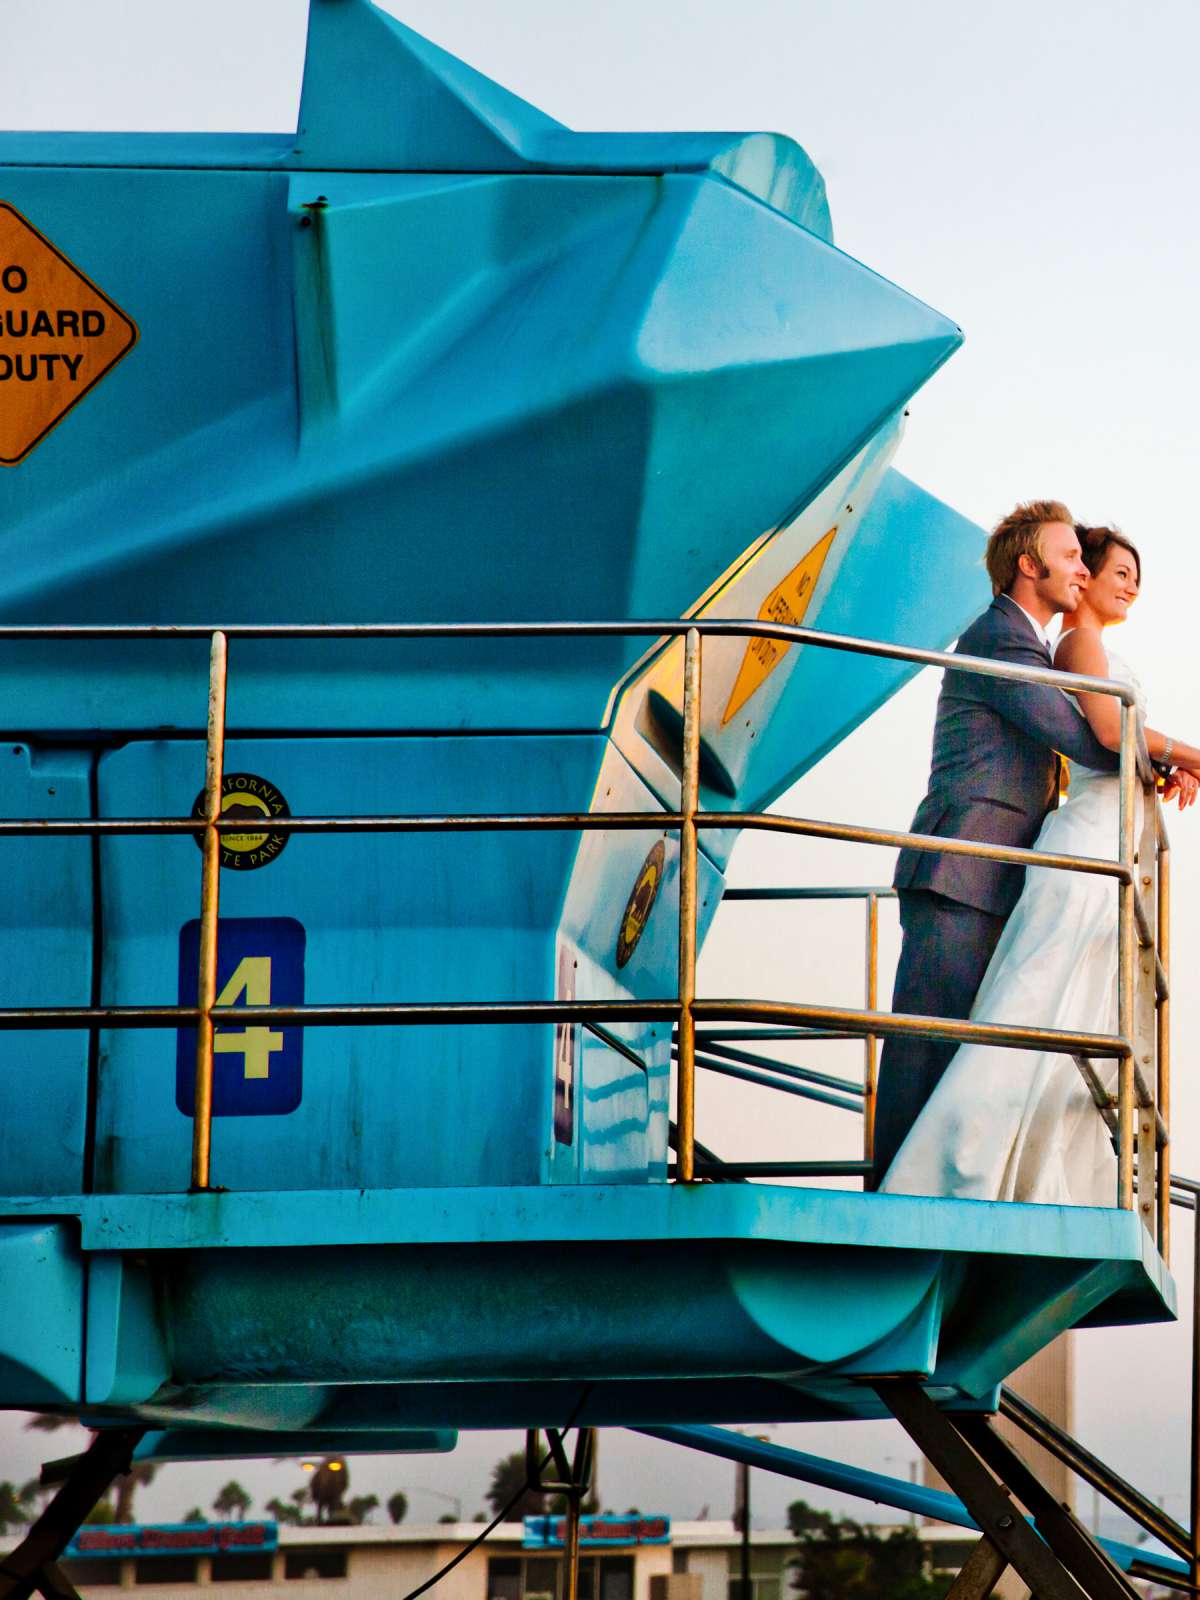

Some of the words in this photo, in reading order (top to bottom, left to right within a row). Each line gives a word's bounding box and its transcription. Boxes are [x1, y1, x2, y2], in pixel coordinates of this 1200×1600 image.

[0, 310, 105, 337] UARD
[0, 354, 84, 381] DUTY
[197, 777, 284, 816] IFORNIA
[250, 835, 284, 865] PARK
[213, 956, 284, 1080] 4
